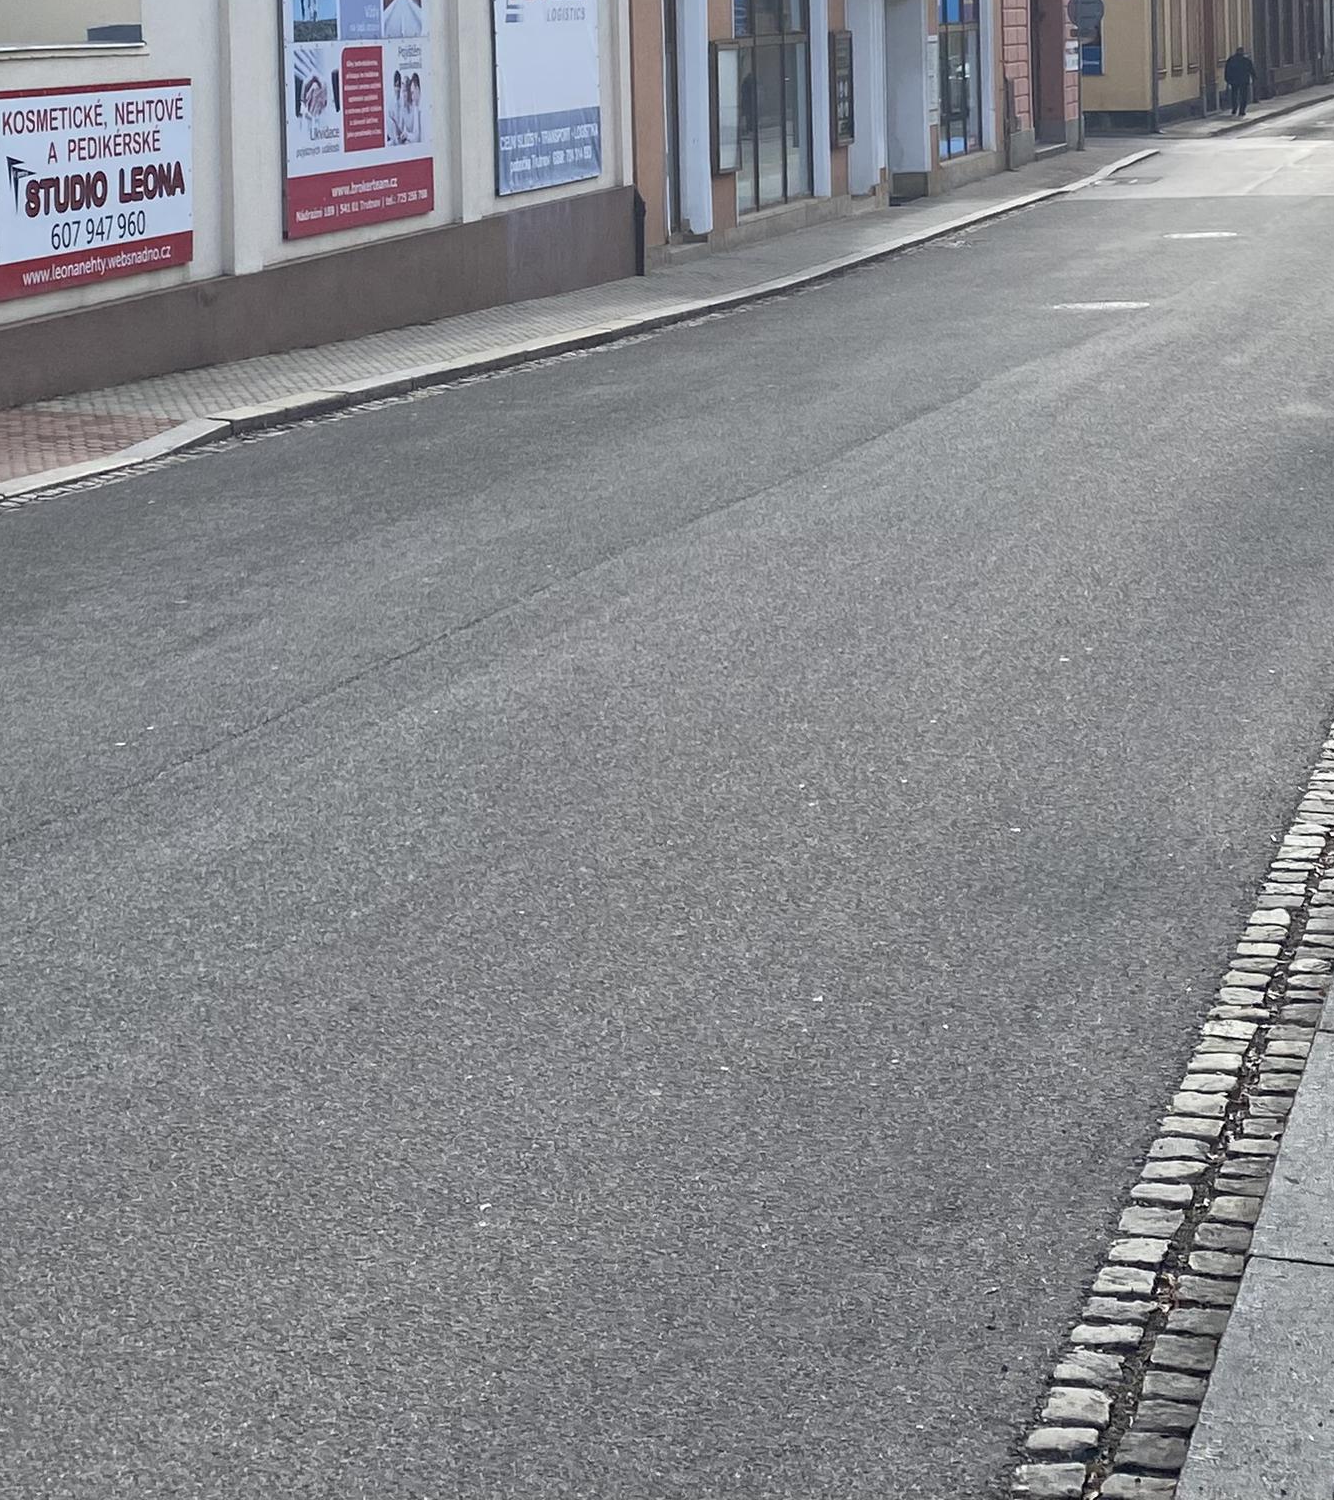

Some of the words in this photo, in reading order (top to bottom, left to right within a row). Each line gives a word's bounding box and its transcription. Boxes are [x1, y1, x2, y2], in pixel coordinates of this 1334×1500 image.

[547, 7, 586, 21] LOGISTICS
[2, 99, 108, 136] KOSMETICKÉ,
[115, 92, 184, 126] NEHTOVÉ
[309, 126, 340, 141] Likvidace
[47, 142, 58, 164] A
[67, 125, 161, 162] PEDIKÉRSKÉ
[25, 171, 108, 218] STUDIO
[119, 160, 186, 203] LEONA
[331, 177, 398, 197] www.brokerteam.cz
[51, 220, 81, 250] 607
[86, 215, 113, 244] 947
[117, 210, 146, 239] 960
[22, 245, 172, 286] www.leonanehty.websnadno.cz
